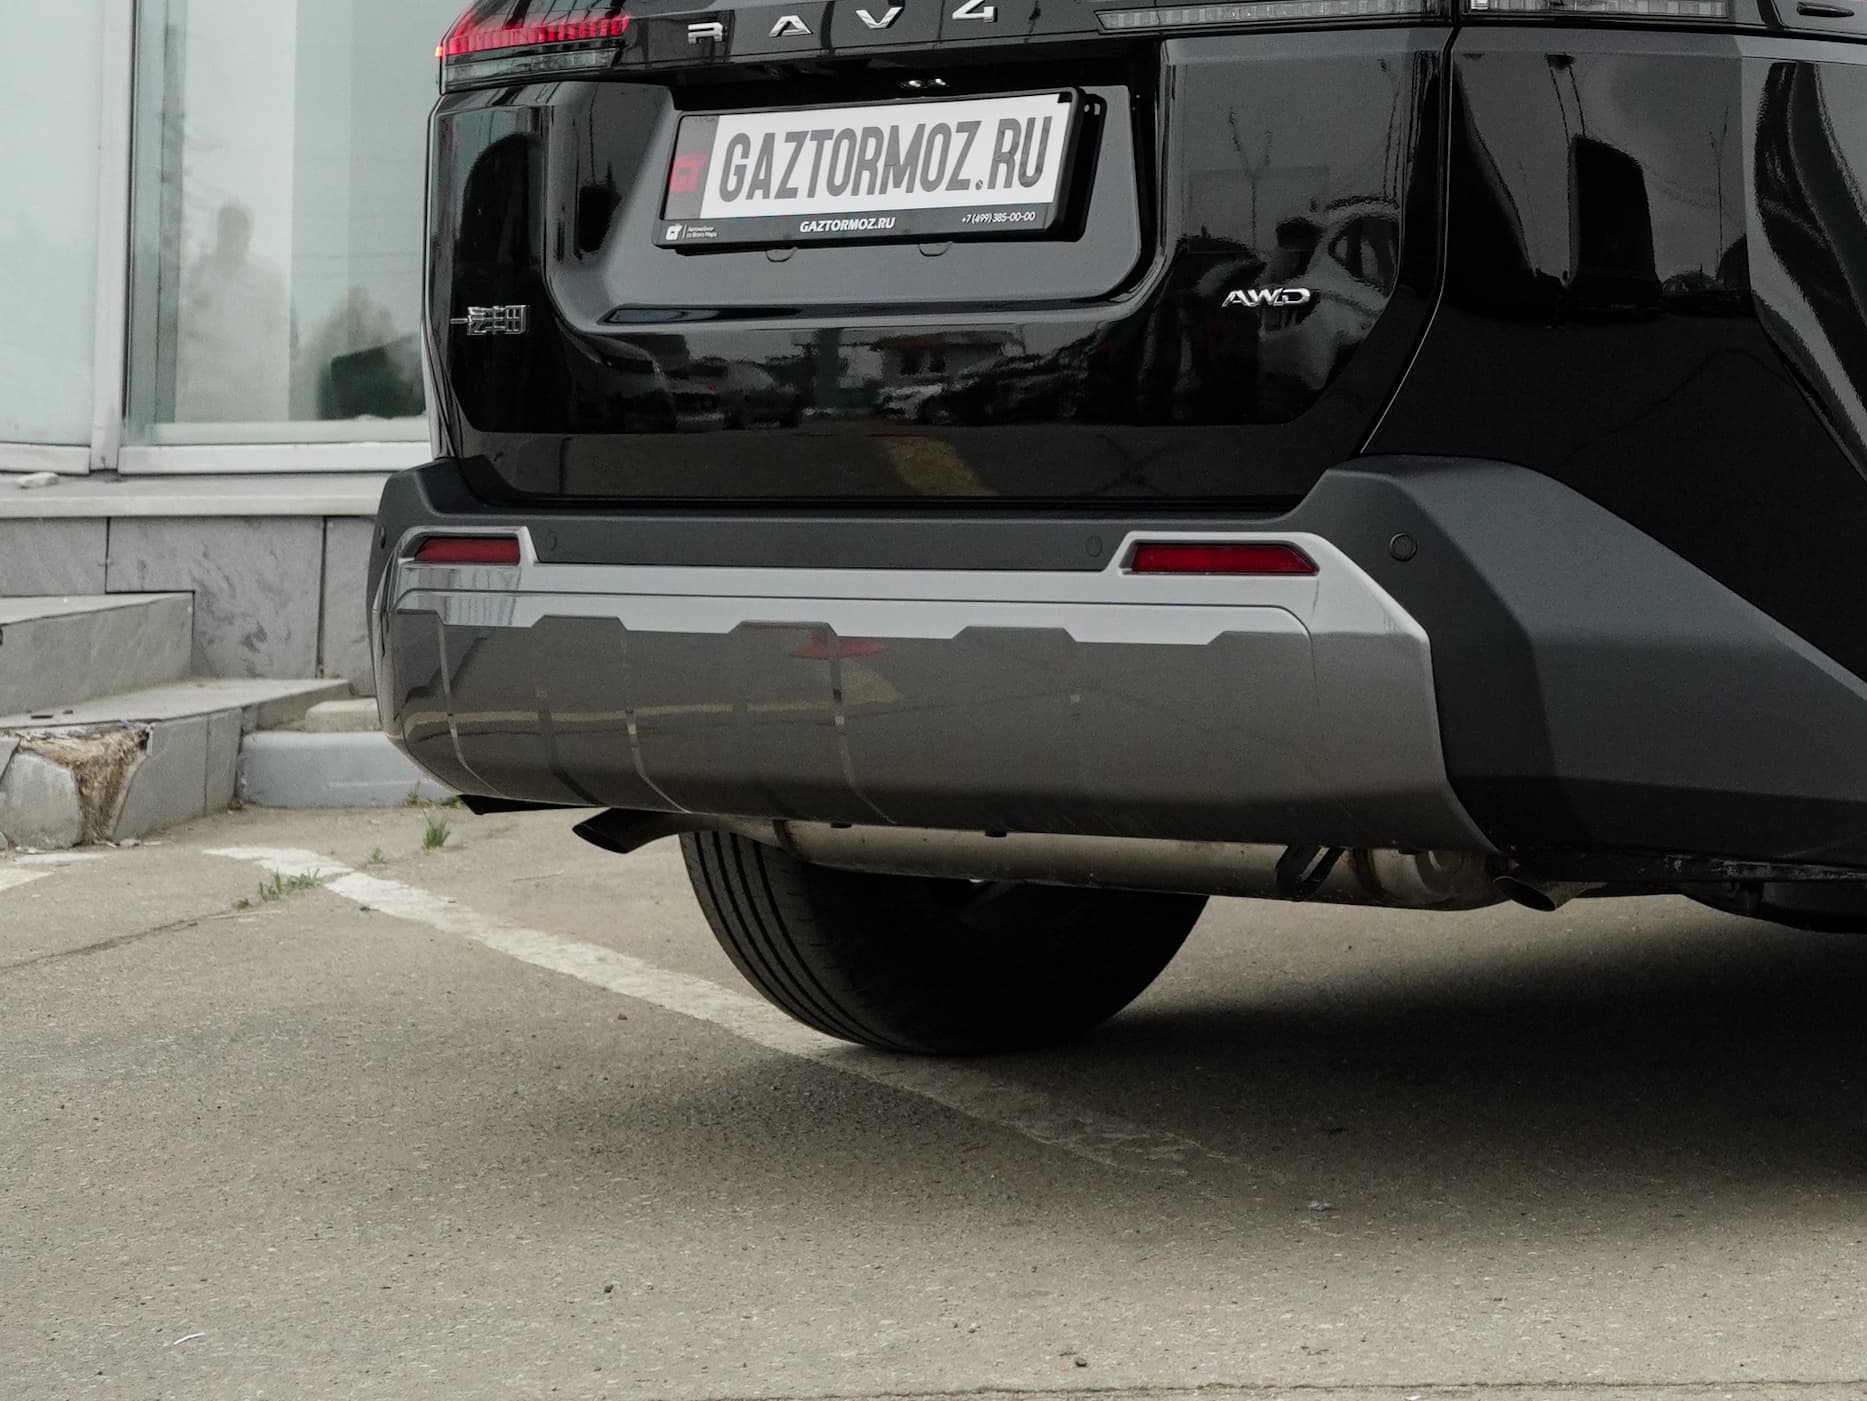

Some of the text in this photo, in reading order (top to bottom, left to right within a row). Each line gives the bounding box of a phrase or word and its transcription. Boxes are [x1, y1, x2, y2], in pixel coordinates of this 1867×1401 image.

[718, 116, 1054, 203] GAZTORMOZ.RU
[799, 216, 896, 233] GAZTORMOZ.RU
[1221, 287, 1311, 308] AWD
